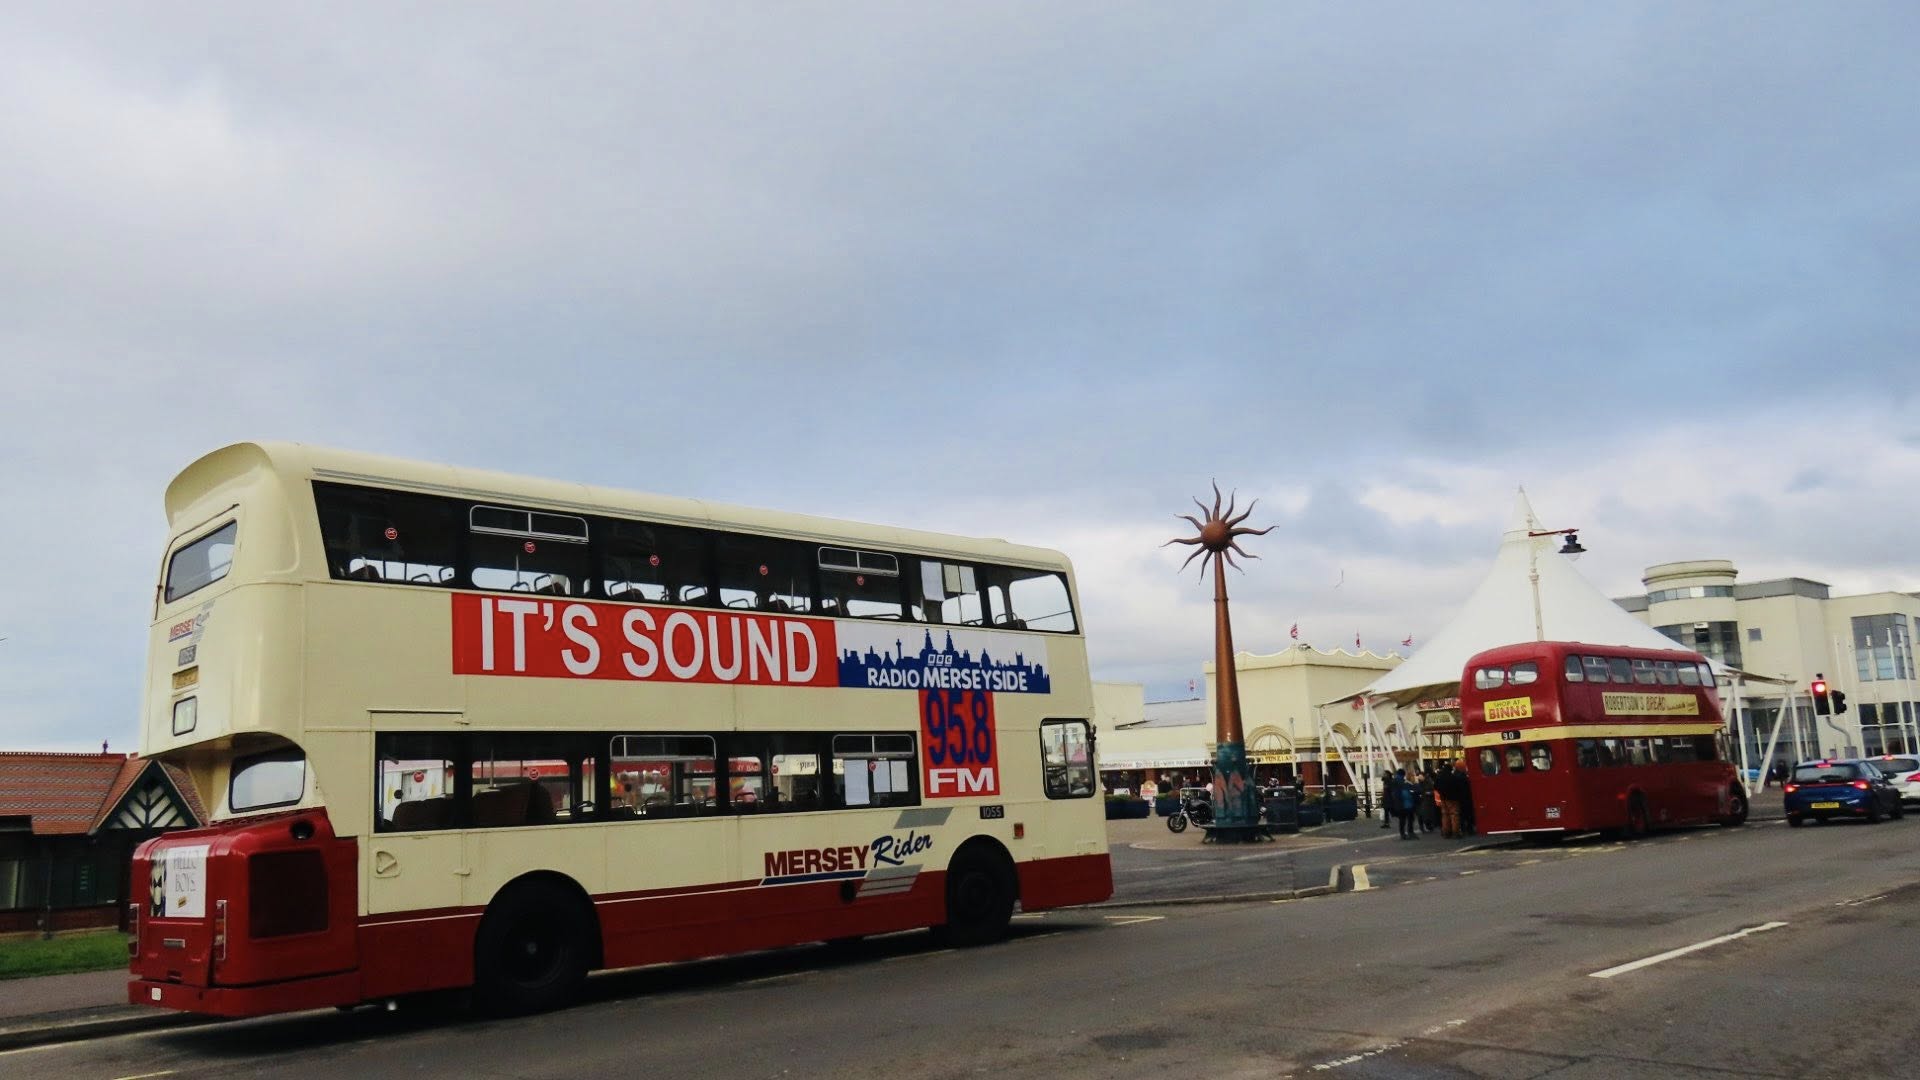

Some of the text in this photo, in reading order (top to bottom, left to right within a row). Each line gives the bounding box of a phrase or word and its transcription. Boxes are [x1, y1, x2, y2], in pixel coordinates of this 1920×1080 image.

[481, 598, 818, 683] IT'S SOUND
[927, 653, 953, 665] BBC
[867, 667, 1028, 691] RADIO MERSEYSIDE
[1489, 704, 1528, 720] BINNS
[926, 688, 991, 766] 95.8
[1502, 732, 1515, 740] 90
[929, 767, 995, 793] FM
[982, 806, 1001, 818] 1055
[765, 830, 933, 877] MERSEY Rider
